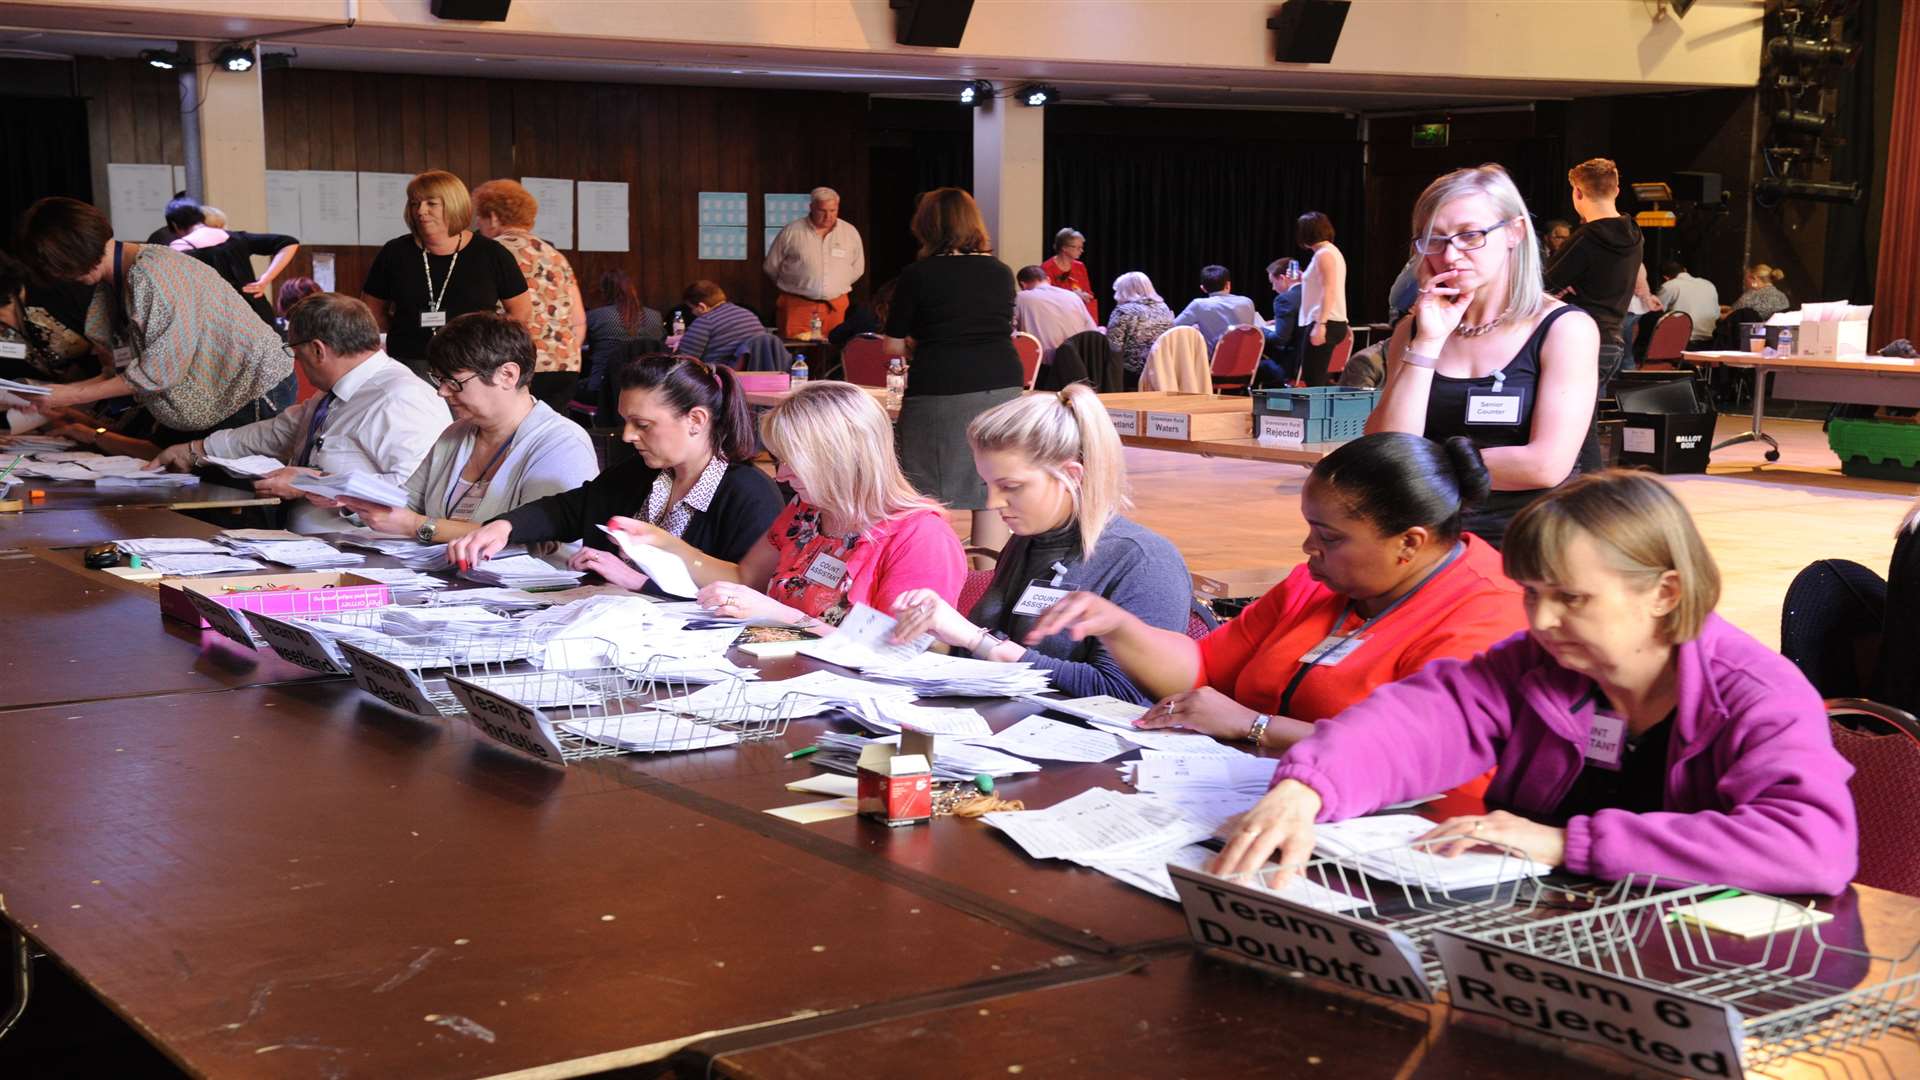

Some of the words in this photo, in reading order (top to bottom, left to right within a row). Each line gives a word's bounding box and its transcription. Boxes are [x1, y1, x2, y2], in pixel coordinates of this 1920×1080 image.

[1113, 420, 1135, 430] etland
[1155, 423, 1180, 433] Waters
[1265, 427, 1300, 439] Rejected
[1676, 435, 1703, 443] BALLOT
[811, 566, 841, 582] ASSISTANT
[819, 561, 841, 574] COUNT
[1021, 600, 1057, 609] ASSISTA
[1032, 594, 1060, 603] COUNT
[343, 648, 397, 682] Team
[398, 671, 412, 688] 6
[365, 675, 420, 713] Death
[461, 685, 517, 724] Team
[517, 709, 531, 730] 6
[1197, 885, 1335, 945] Team
[1348, 930, 1382, 957] 6
[1197, 917, 1423, 1001] Doubtful
[1465, 943, 1632, 1014] Team
[1654, 998, 1692, 1029] 6
[1456, 975, 1730, 1078] Rejected
